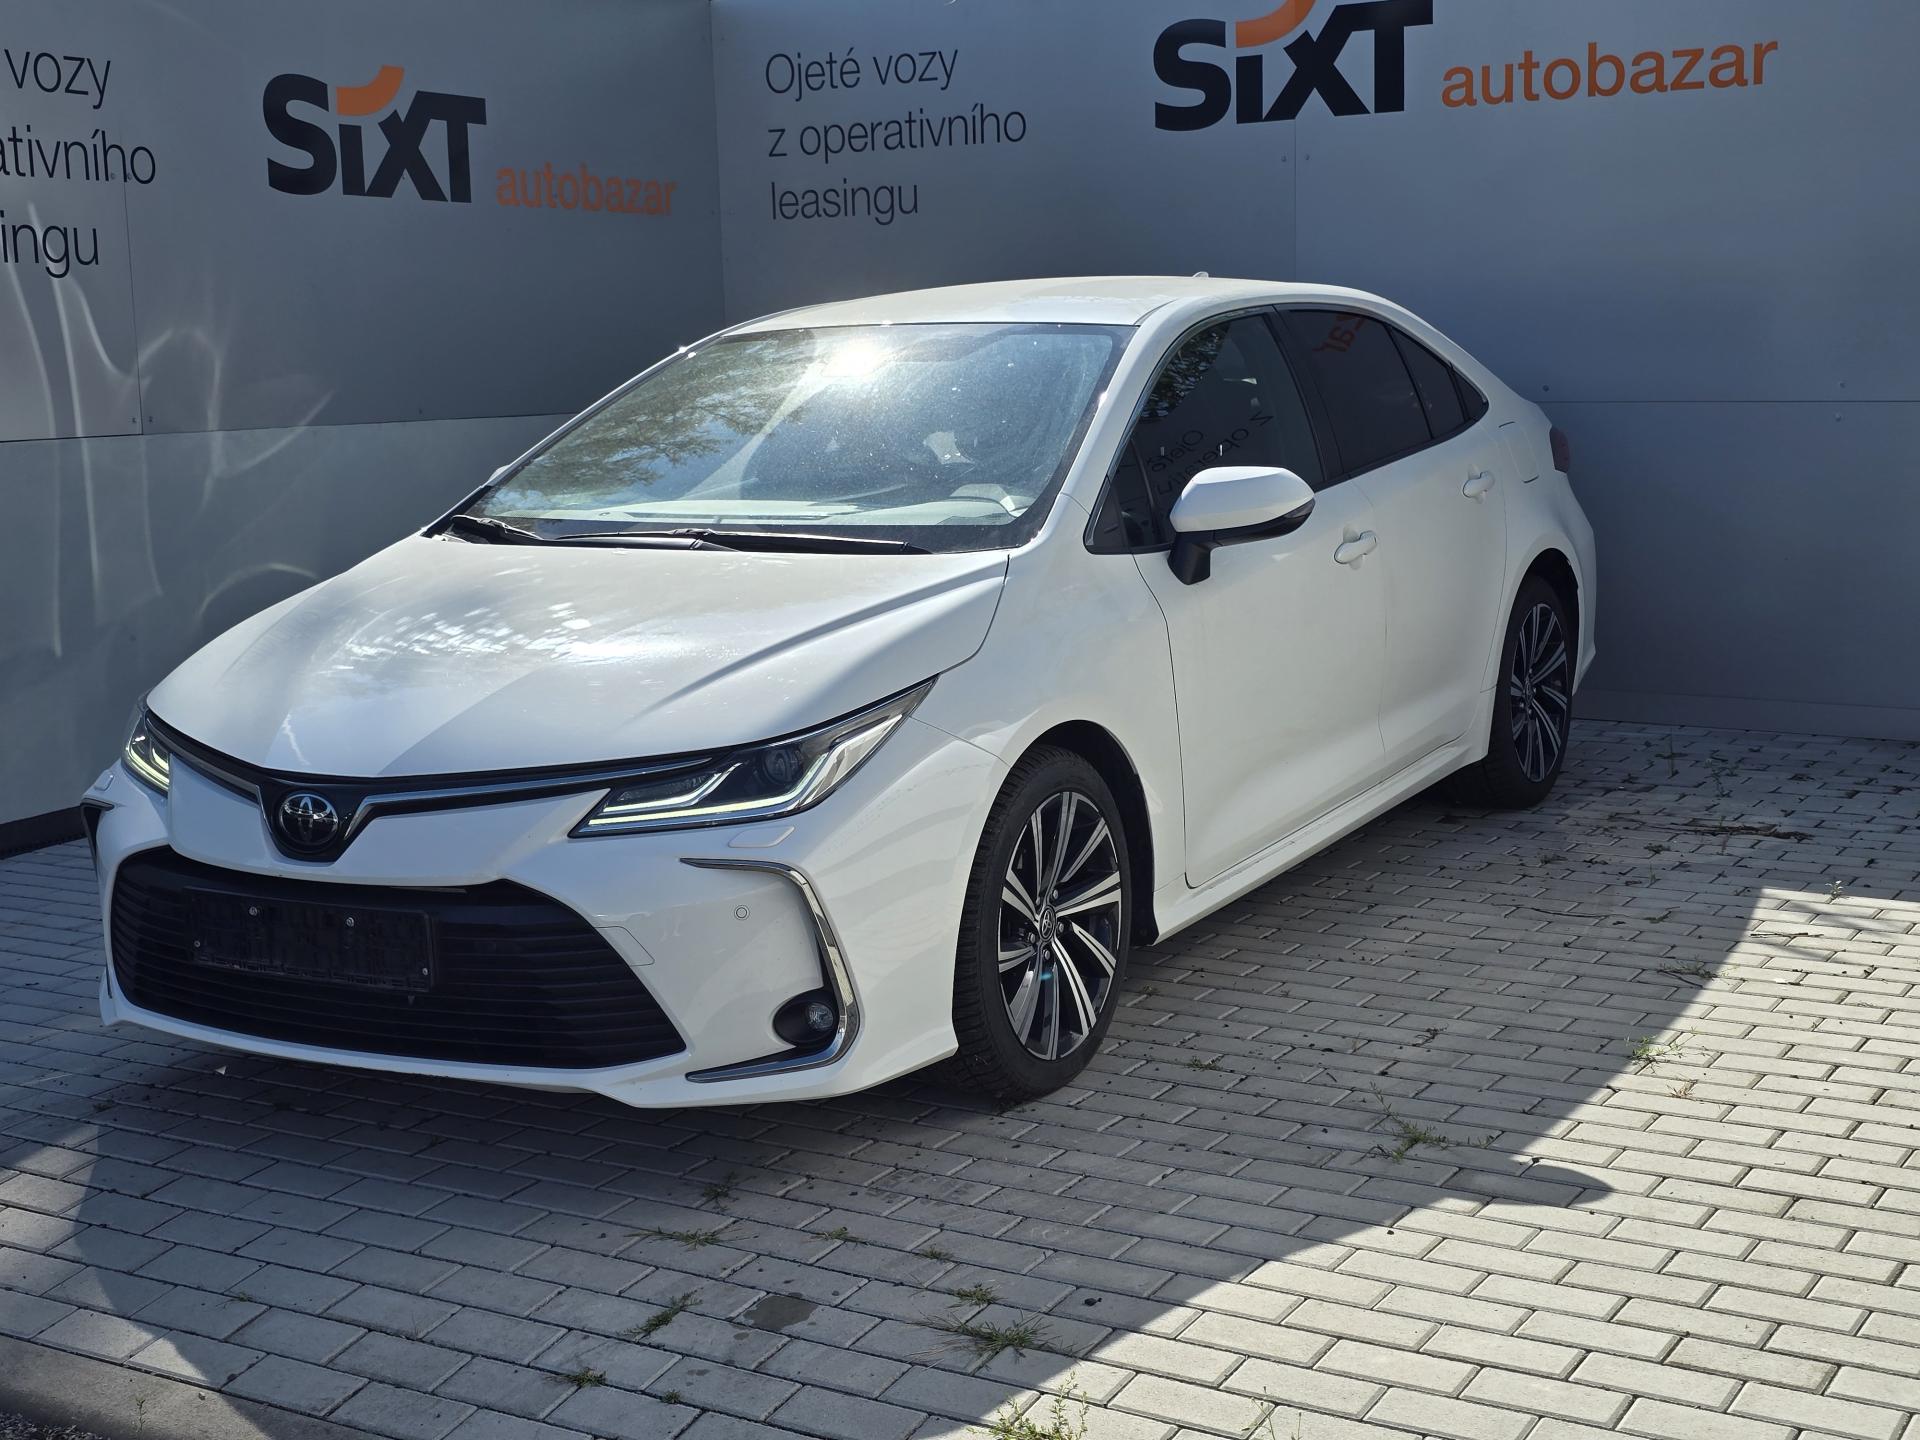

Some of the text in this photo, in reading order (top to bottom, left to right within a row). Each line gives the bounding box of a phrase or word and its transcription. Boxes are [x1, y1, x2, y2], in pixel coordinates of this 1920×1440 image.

[4, 49, 112, 110] vozy
[765, 46, 959, 102] Ojeté vozy
[1441, 40, 1779, 108] autobazar
[767, 102, 1027, 165] z operativního
[496, 161, 678, 216] autobazar
[771, 177, 919, 226] leasingu
[0, 209, 99, 279] ingu
